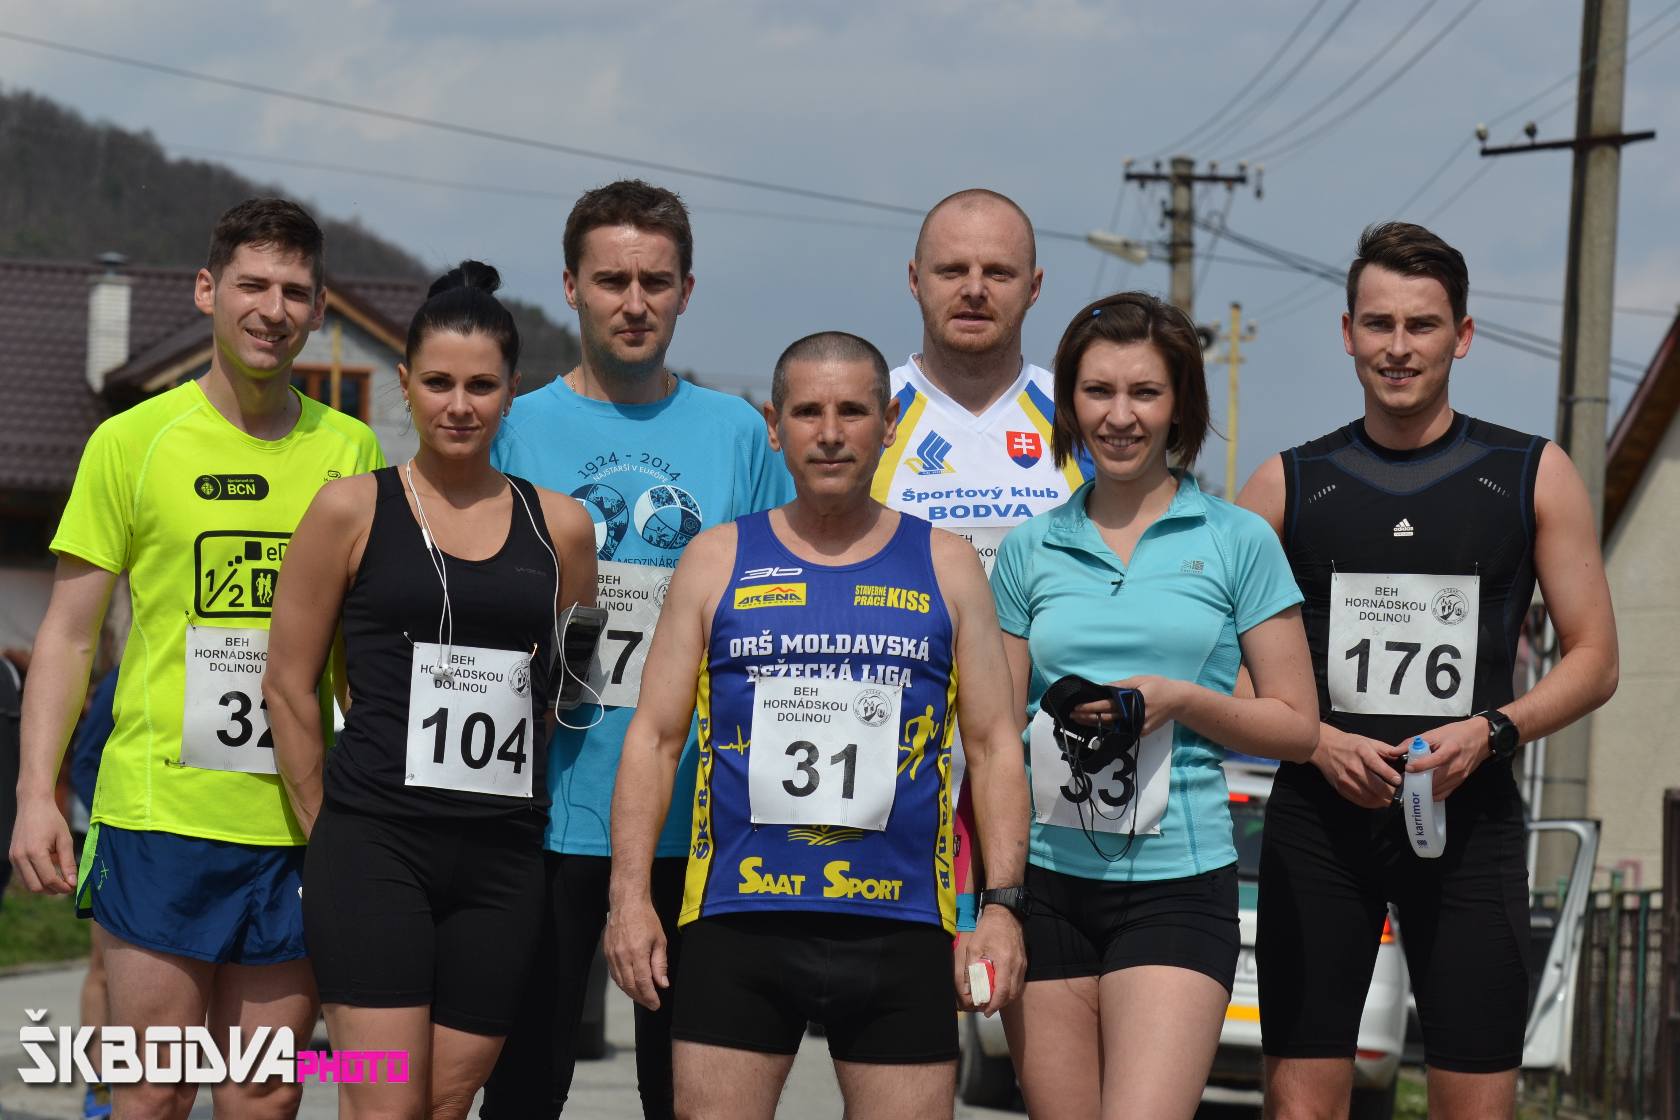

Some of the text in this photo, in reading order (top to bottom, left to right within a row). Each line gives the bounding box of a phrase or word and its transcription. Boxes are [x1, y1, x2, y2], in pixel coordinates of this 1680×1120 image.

[577, 451, 620, 479] 1924
[639, 452, 681, 482] 2014
[227, 483, 256, 495] BCN
[902, 486, 1059, 503] Športový klub
[928, 503, 1034, 521] BODVA
[597, 574, 621, 585] BEH
[1375, 586, 1399, 597] BEH
[738, 593, 803, 606] ARENA
[886, 587, 931, 614] KISS
[1345, 597, 1427, 612] HORNÁDSKOU
[1359, 611, 1411, 623] DOLINOU
[225, 637, 249, 647] BEH
[729, 630, 930, 662] ORŠ MOLDAVSKÁ
[451, 654, 476, 666] BEH
[209, 662, 262, 674] DOLINOU
[1345, 638, 1462, 700] 176
[860, 664, 912, 688] LIGA
[434, 679, 488, 694] DOLINOU
[793, 686, 819, 697] BEH
[763, 697, 848, 712] HORNÁDSKOU
[777, 712, 832, 724] DOLINOU
[421, 707, 527, 775] 104
[781, 740, 858, 800] 31
[1411, 791, 1424, 836] karrimor
[738, 856, 903, 901] SAAT SPORT
